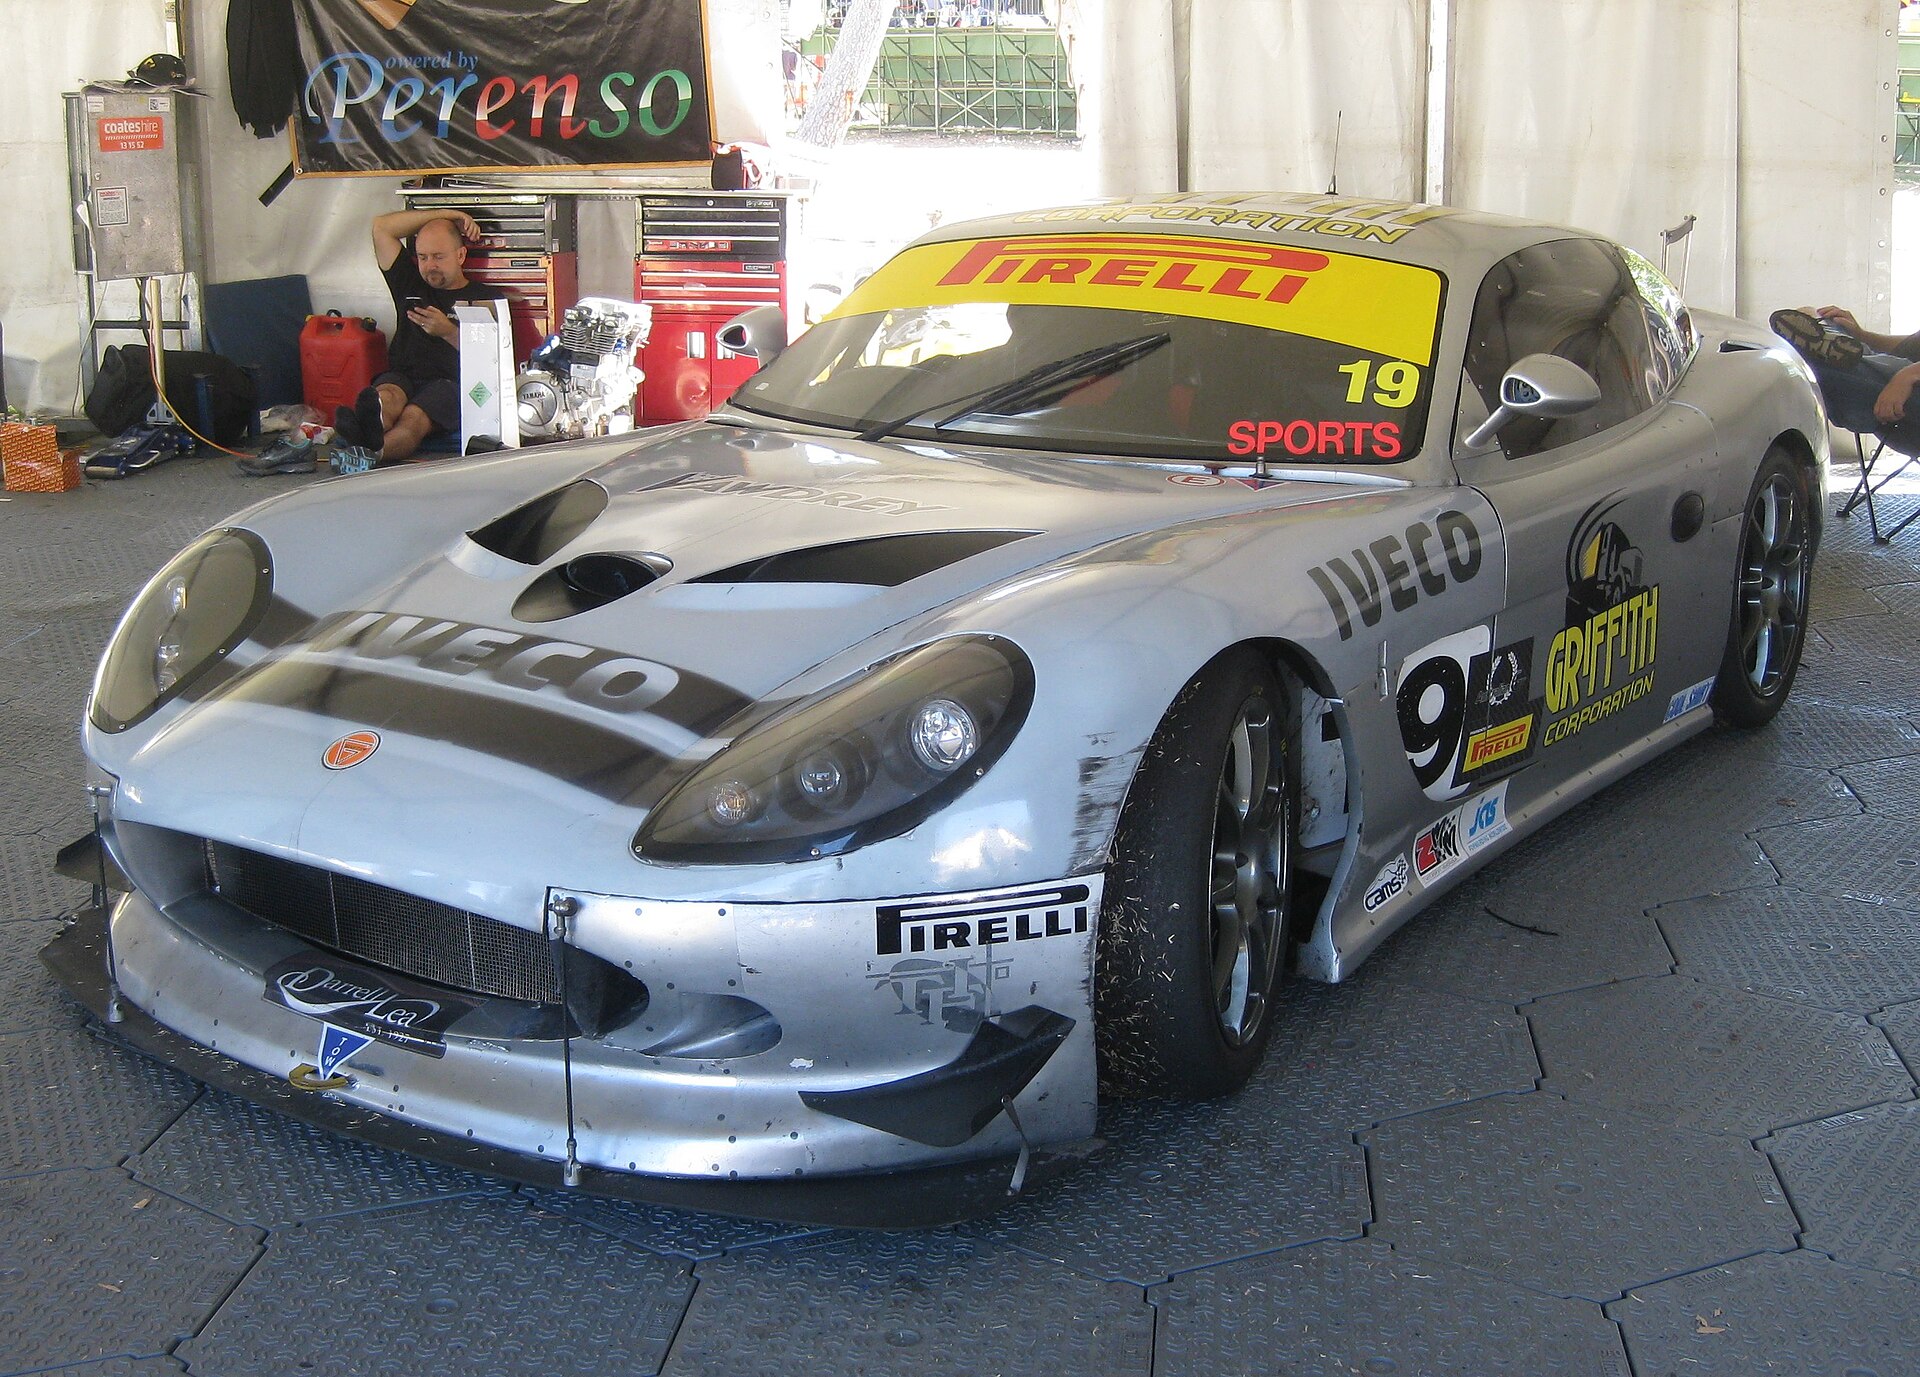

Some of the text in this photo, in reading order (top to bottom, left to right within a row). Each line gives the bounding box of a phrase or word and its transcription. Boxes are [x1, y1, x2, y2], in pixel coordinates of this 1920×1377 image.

[457, 53, 478, 73] by
[305, 52, 692, 144] Perenso
[1013, 206, 1415, 244] CORPORATION
[936, 235, 1330, 305] PIRELLI
[522, 391, 545, 400] YAMAHA
[1337, 360, 1421, 408] 19
[1228, 420, 1401, 458] SPORTS
[1307, 510, 1482, 641] IVECO
[309, 612, 680, 713] IVECO
[1545, 585, 1660, 714] GRIFFITH
[1543, 670, 1655, 747] CORPORATION
[1471, 723, 1527, 763] PIRELLI
[876, 884, 1090, 956] PIRELLI
[277, 967, 417, 1028] Darrell Lea
[325, 1036, 347, 1067] TOW
